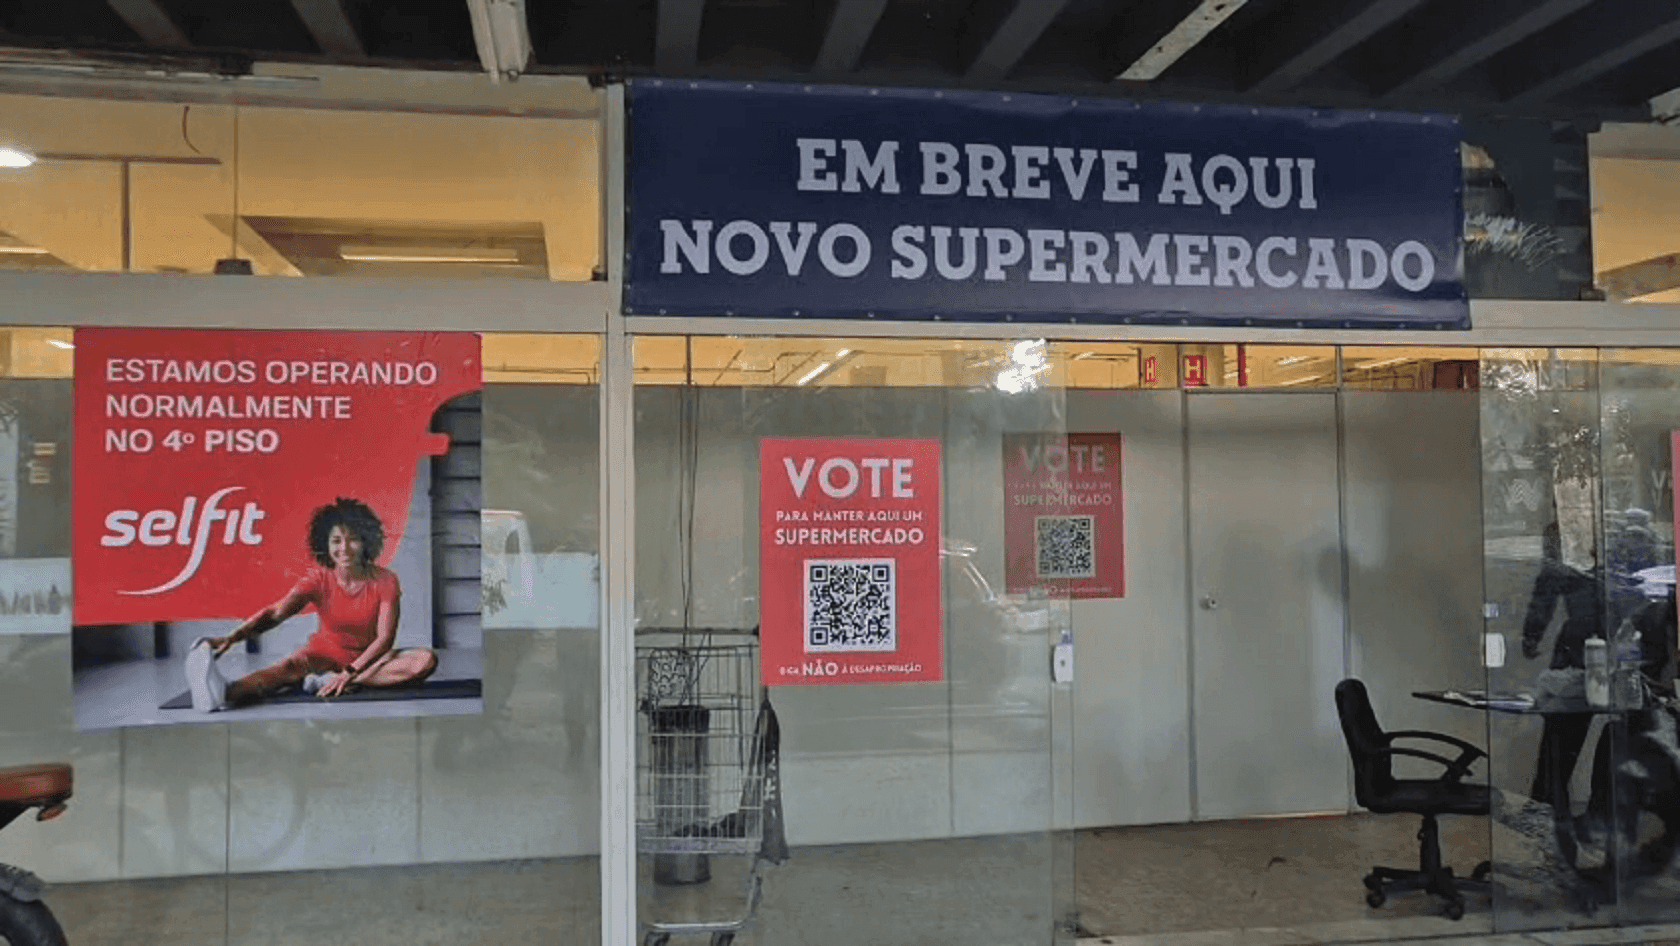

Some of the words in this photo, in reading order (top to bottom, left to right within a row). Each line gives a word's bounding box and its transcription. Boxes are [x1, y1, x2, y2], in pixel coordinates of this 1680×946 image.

[796, 137, 898, 196] EM
[919, 141, 1139, 203] BREVE
[1158, 152, 1317, 215] AQUI
[660, 219, 871, 278] NOVO
[890, 224, 1435, 293] SUPERMERCADO
[106, 359, 257, 384] ESTAMOS
[266, 361, 438, 387] OPERANDO
[105, 395, 352, 420] NORMALMENTE
[105, 429, 154, 453] NO
[205, 429, 280, 454] PISO
[1020, 445, 1105, 473] VOTE
[783, 457, 915, 499] VOTE
[776, 510, 809, 521] PARA
[813, 510, 865, 521] MANTER
[867, 510, 900, 521] AQUI
[904, 510, 922, 521] UM
[100, 486, 266, 595] selfit
[774, 528, 924, 545] SUPERMERCADO
[802, 659, 839, 676] NÃO
